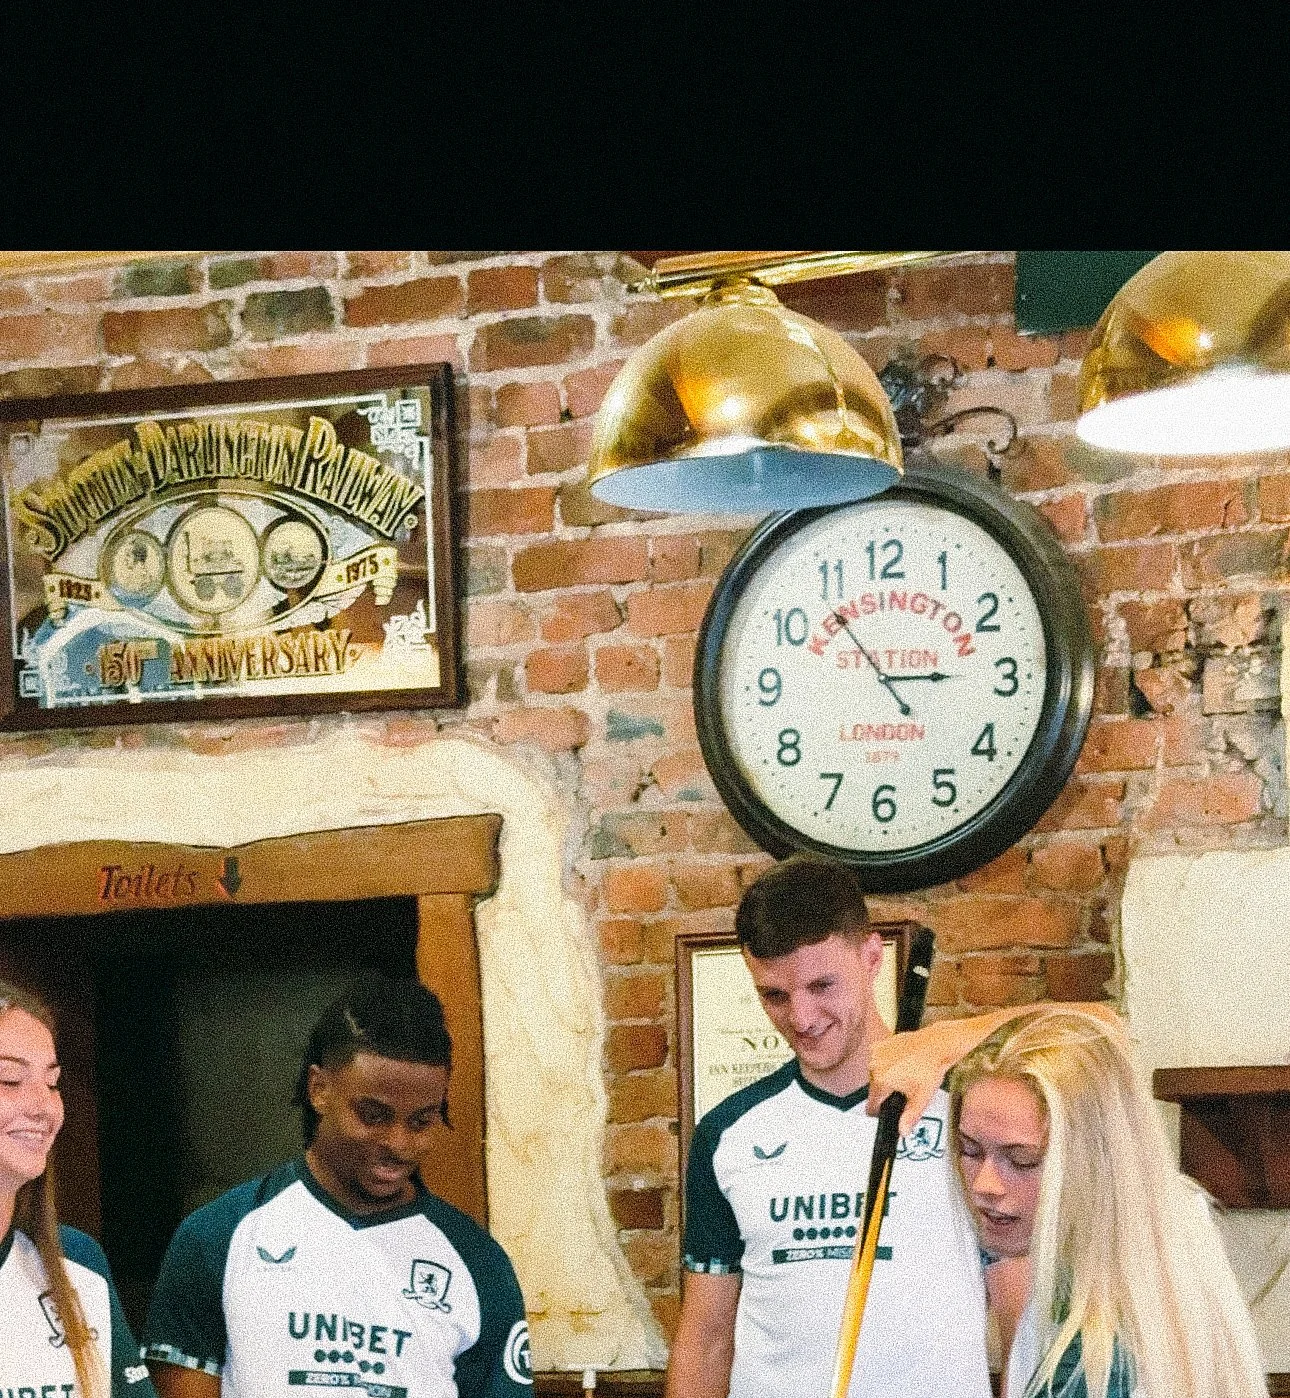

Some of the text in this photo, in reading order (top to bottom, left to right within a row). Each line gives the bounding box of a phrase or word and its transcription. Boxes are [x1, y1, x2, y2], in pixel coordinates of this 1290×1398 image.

[294, 415, 425, 538] RAILWAY
[346, 553, 379, 583] 1975
[865, 538, 905, 580] 12
[937, 551, 949, 591] 1
[818, 560, 844, 601] 11
[773, 608, 809, 647] 10
[806, 589, 977, 658] KENSINGTON
[975, 592, 1001, 633] 2
[171, 628, 352, 684] ANNIVERSARY
[836, 648, 939, 670] STATION
[757, 667, 782, 707] 9
[993, 657, 1019, 698] 3
[776, 728, 801, 768] 8
[838, 722, 925, 742] LONDON
[971, 723, 996, 762] 4
[819, 772, 844, 811] 7
[871, 784, 897, 823] 6
[931, 769, 957, 808] 5
[100, 864, 200, 900] Toilets
